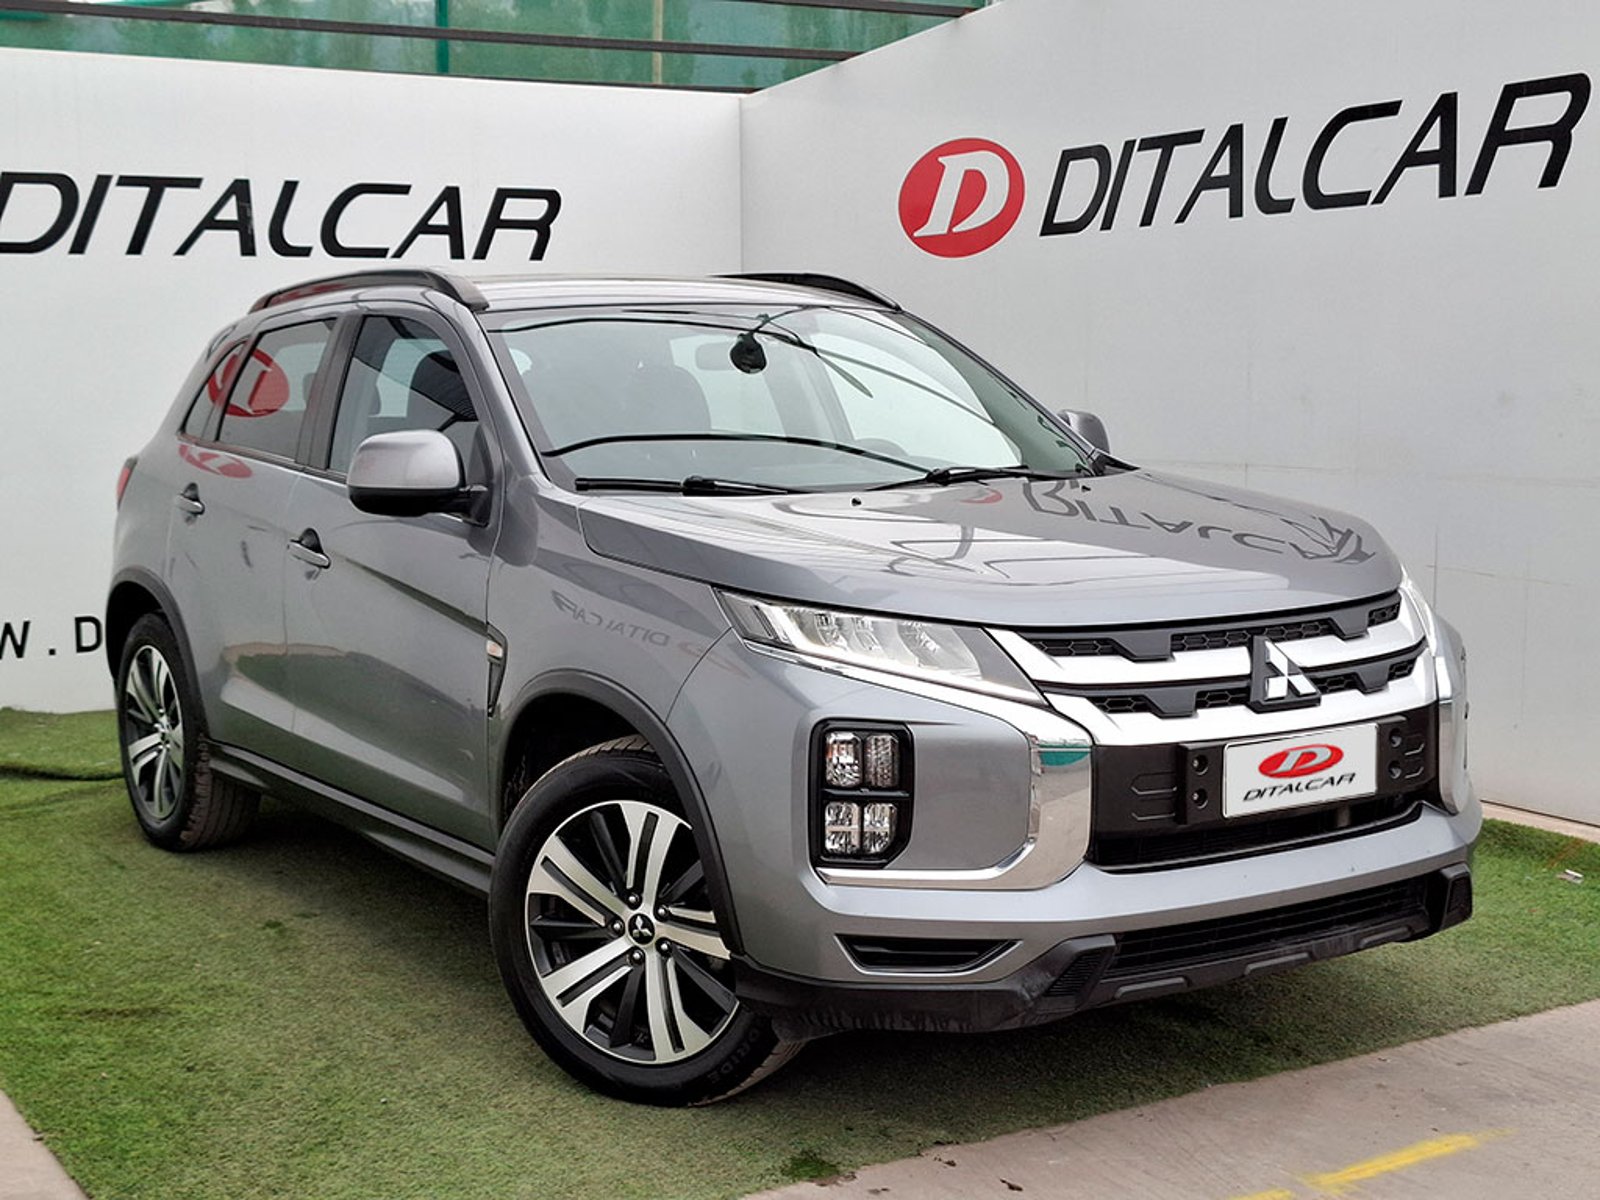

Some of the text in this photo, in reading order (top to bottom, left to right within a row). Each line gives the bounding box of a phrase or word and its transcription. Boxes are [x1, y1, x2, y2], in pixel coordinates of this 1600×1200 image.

[1038, 71, 1592, 237] DITALCAR
[0, 171, 562, 261] DITALCAR
[1242, 771, 1357, 801] DITALCAR
